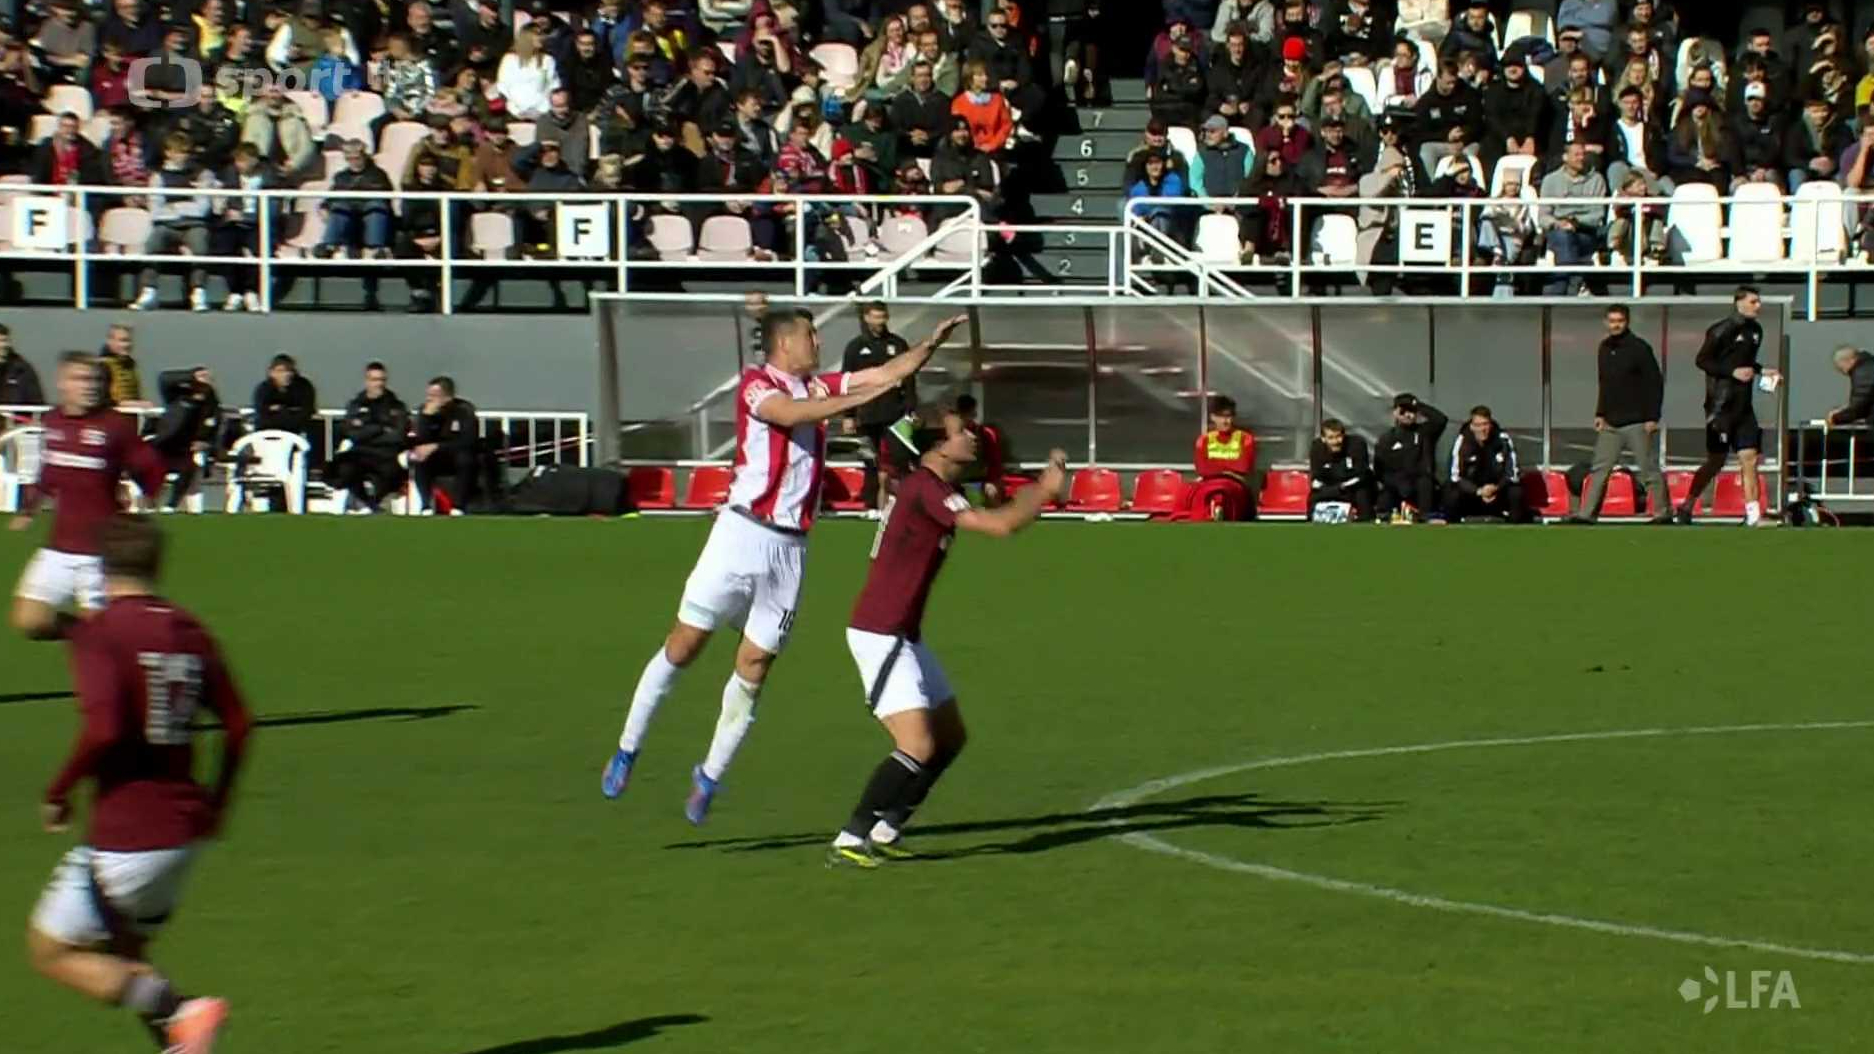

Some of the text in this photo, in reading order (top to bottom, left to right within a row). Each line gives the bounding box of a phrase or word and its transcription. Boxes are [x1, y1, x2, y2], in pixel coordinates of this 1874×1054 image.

[1093, 111, 1103, 128] 7
[1080, 139, 1093, 158] 6
[1076, 168, 1089, 186] 5
[1070, 198, 1085, 216] 4
[27, 208, 49, 236] F
[572, 217, 593, 246] F
[1414, 222, 1435, 250] E
[1058, 258, 1072, 276] 2
